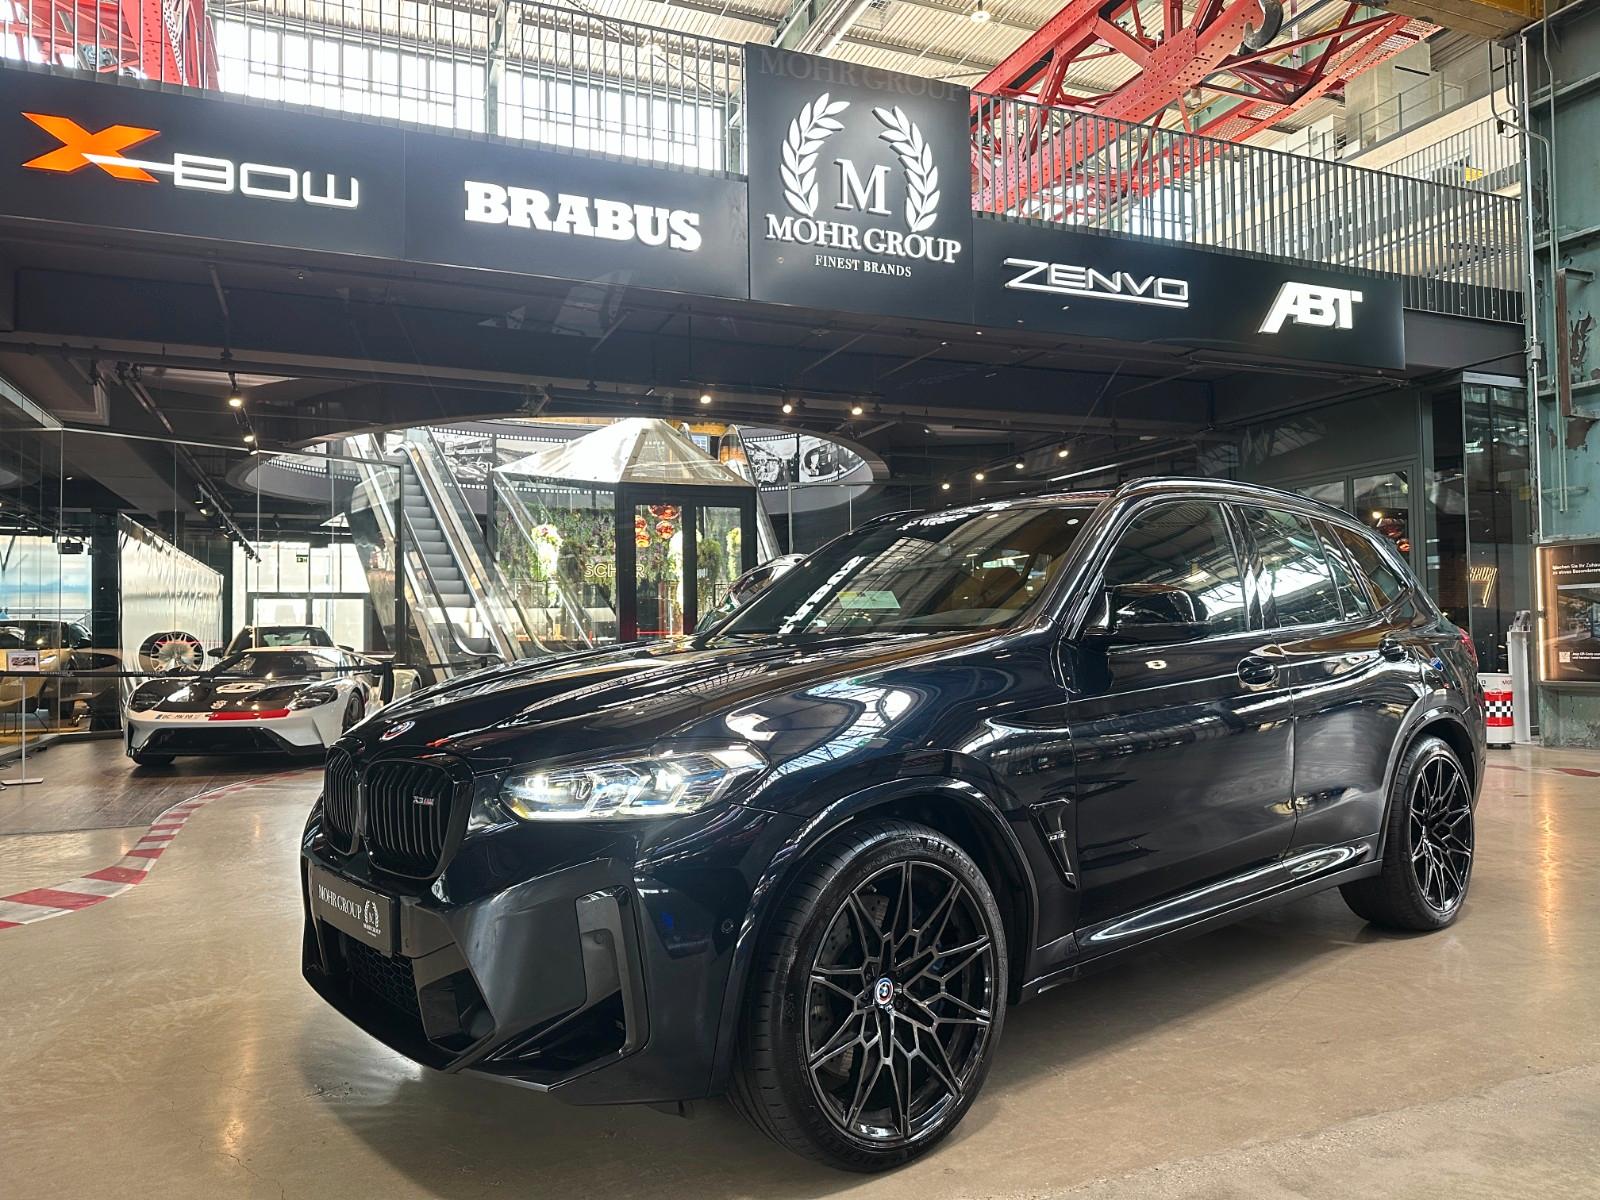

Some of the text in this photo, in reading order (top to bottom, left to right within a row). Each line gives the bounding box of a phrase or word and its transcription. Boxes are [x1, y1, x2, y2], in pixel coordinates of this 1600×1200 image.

[760, 51, 964, 101] MOHR GROUP
[834, 158, 892, 215] M
[464, 180, 702, 252] BRABUS
[765, 213, 962, 263] MOHR GROUP
[815, 254, 913, 278] FINEST BRANDS
[1004, 257, 1189, 308] ZENVO
[1257, 281, 1364, 335] ABT
